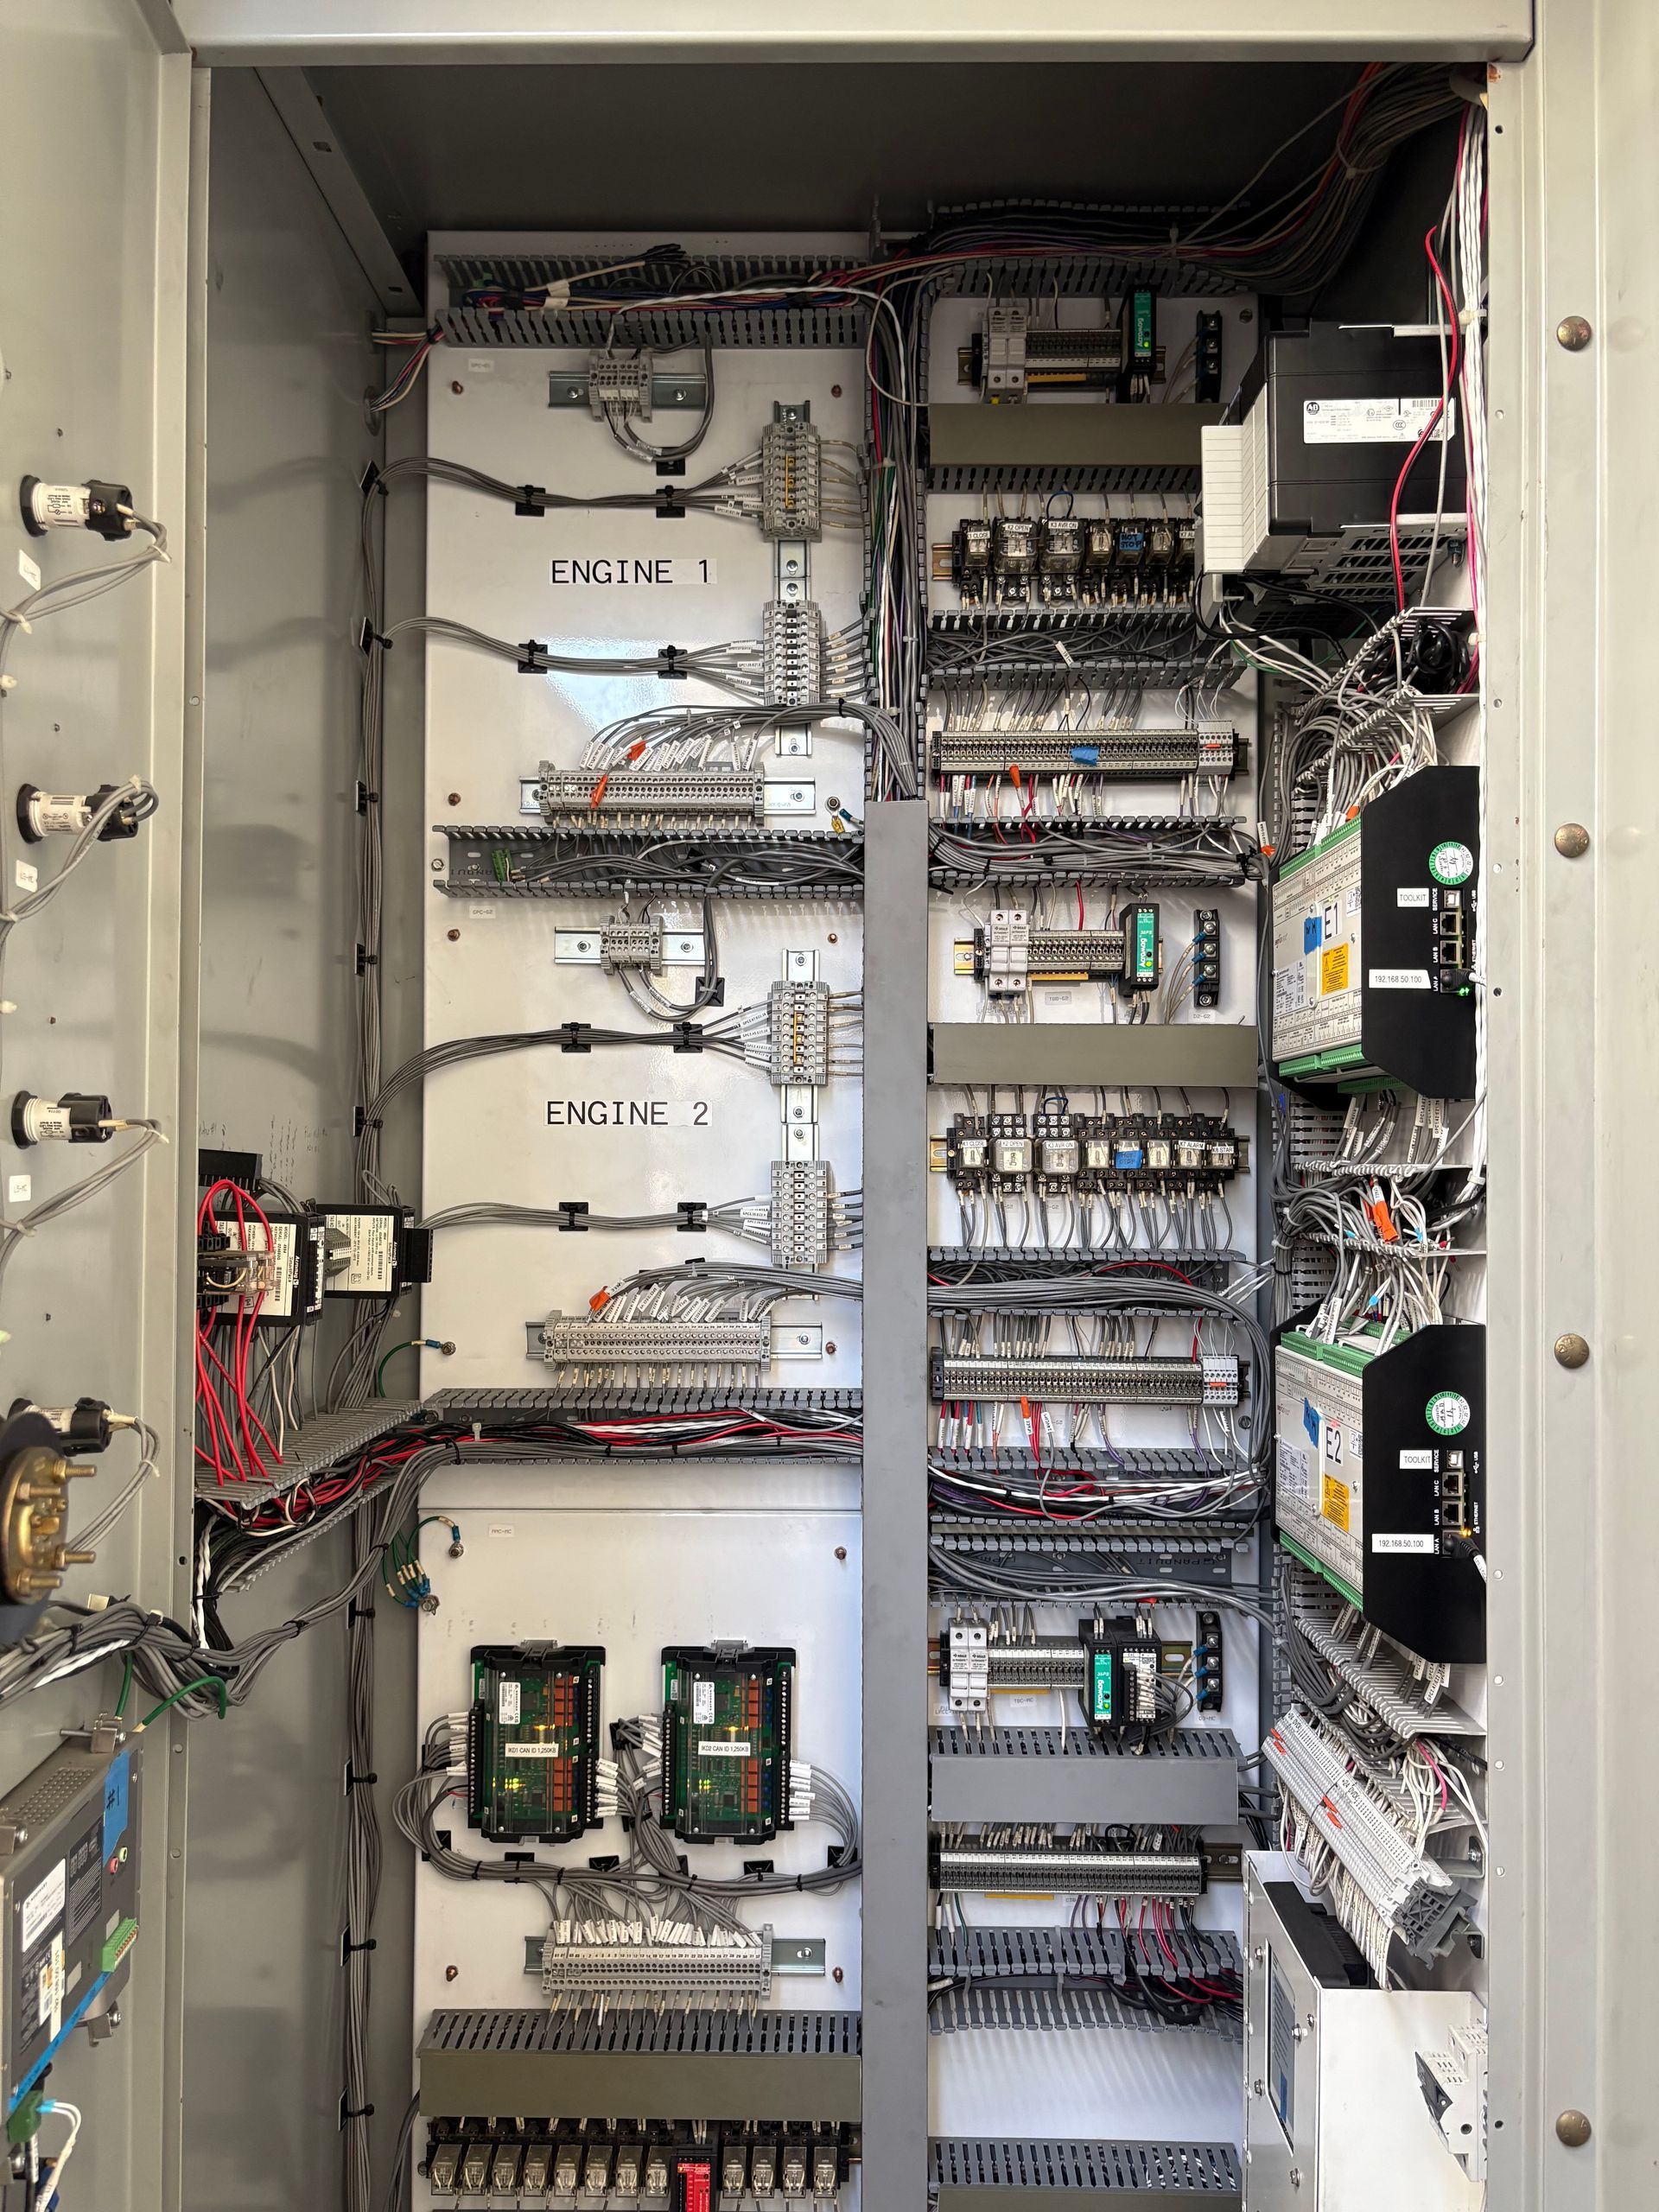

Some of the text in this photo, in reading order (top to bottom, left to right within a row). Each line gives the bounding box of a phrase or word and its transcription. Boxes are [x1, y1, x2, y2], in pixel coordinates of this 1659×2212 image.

[551, 559, 708, 584] ENGINE 1
[1400, 893, 1427, 901] TOOLKIT
[1325, 905, 1338, 940] E1
[1139, 938, 1147, 968] Acromag
[1375, 975, 1422, 984] 192.168.50.100
[547, 1101, 709, 1125] ENGINE 2
[1325, 1426, 1341, 1464] E2
[1404, 1455, 1431, 1465] TOOLKIT
[1378, 1539, 1424, 1548] 192.168.50.100
[1096, 1680, 1105, 1710] Acromag
